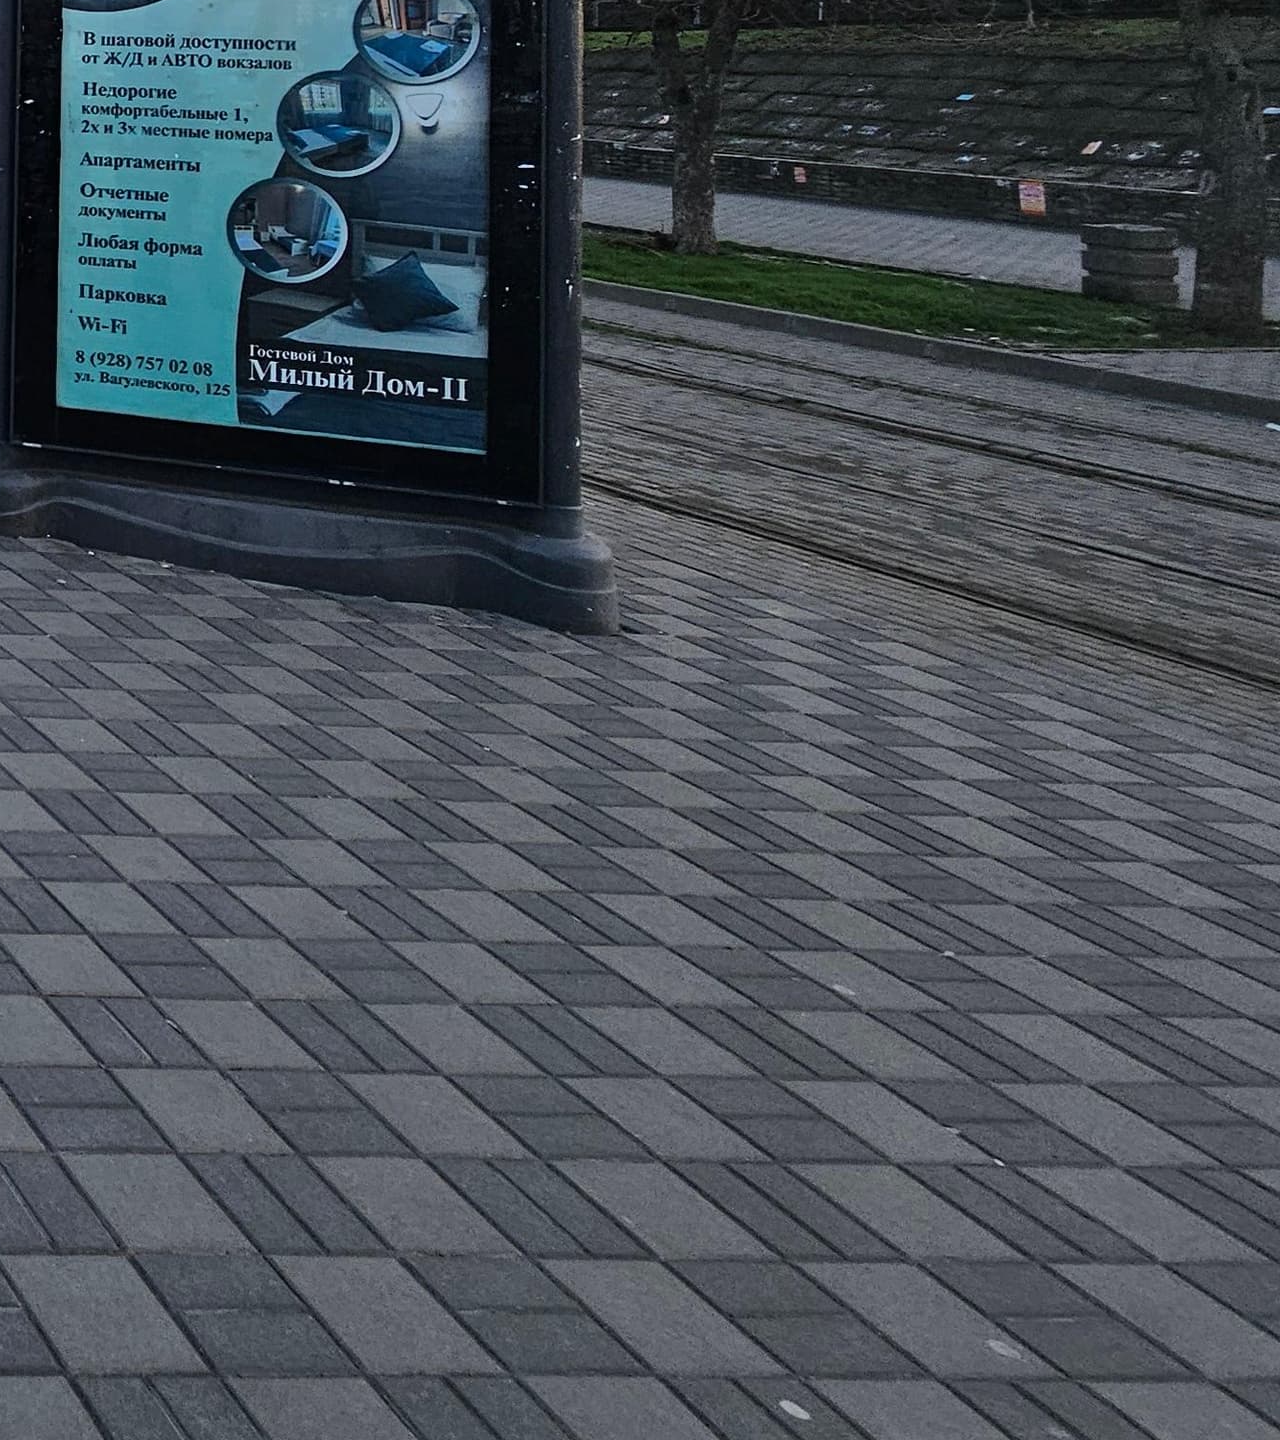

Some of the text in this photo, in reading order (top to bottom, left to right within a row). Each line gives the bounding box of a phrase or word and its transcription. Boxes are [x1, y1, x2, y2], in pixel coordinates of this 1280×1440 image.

[83, 31, 297, 52] В шаговой доступности
[82, 51, 292, 70] от Ж/Д и АВТО вокзалов
[83, 82, 177, 101] Недорогие
[81, 103, 248, 124] комфортабельные 1,
[81, 119, 273, 143] 2х и 3х местные номера
[80, 151, 201, 172] Апартаменты
[80, 182, 169, 202] Отчетные
[78, 205, 166, 221] документы
[78, 232, 203, 257] Любая форма
[78, 255, 137, 269] оплаты
[79, 283, 167, 305] Парковка
[78, 315, 127, 334] Wi-Fi
[75, 350, 213, 377] 8 (928) 757 02 08
[249, 344, 354, 366] Гостевой Дом
[74, 371, 231, 396] ул. Вагулевского, 125
[248, 359, 469, 402] Милый Дом-II
